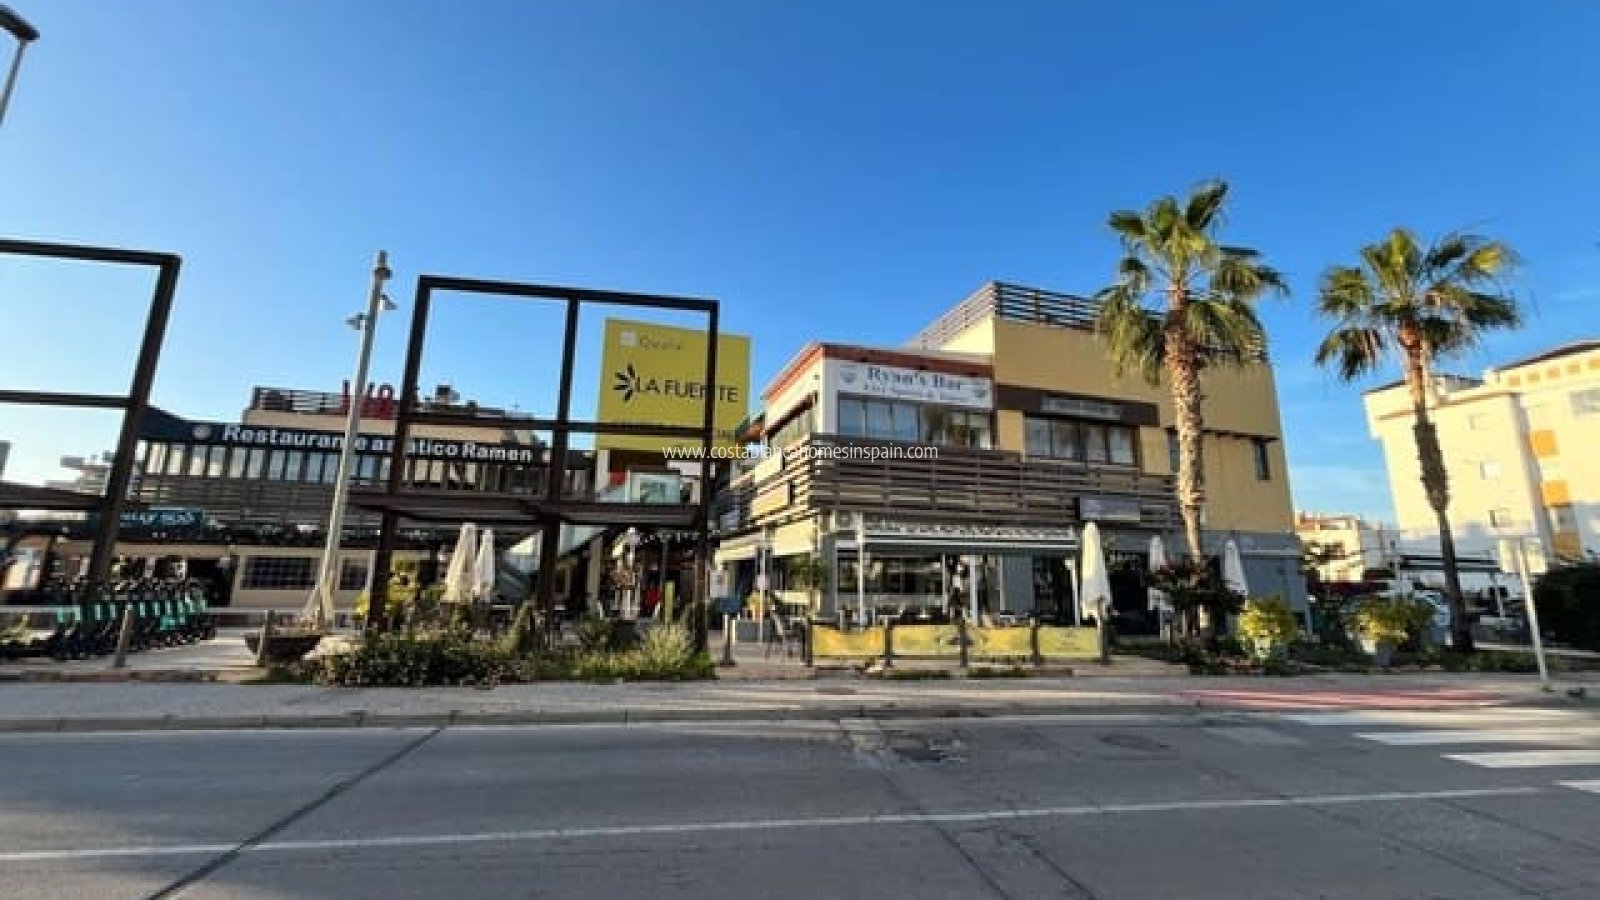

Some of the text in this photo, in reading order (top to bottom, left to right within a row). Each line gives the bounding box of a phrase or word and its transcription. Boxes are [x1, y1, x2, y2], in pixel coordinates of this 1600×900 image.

[635, 376, 661, 394] LA
[867, 366, 961, 390] Ryan's Bar
[223, 424, 531, 463] Restaurane asatico Ramen
